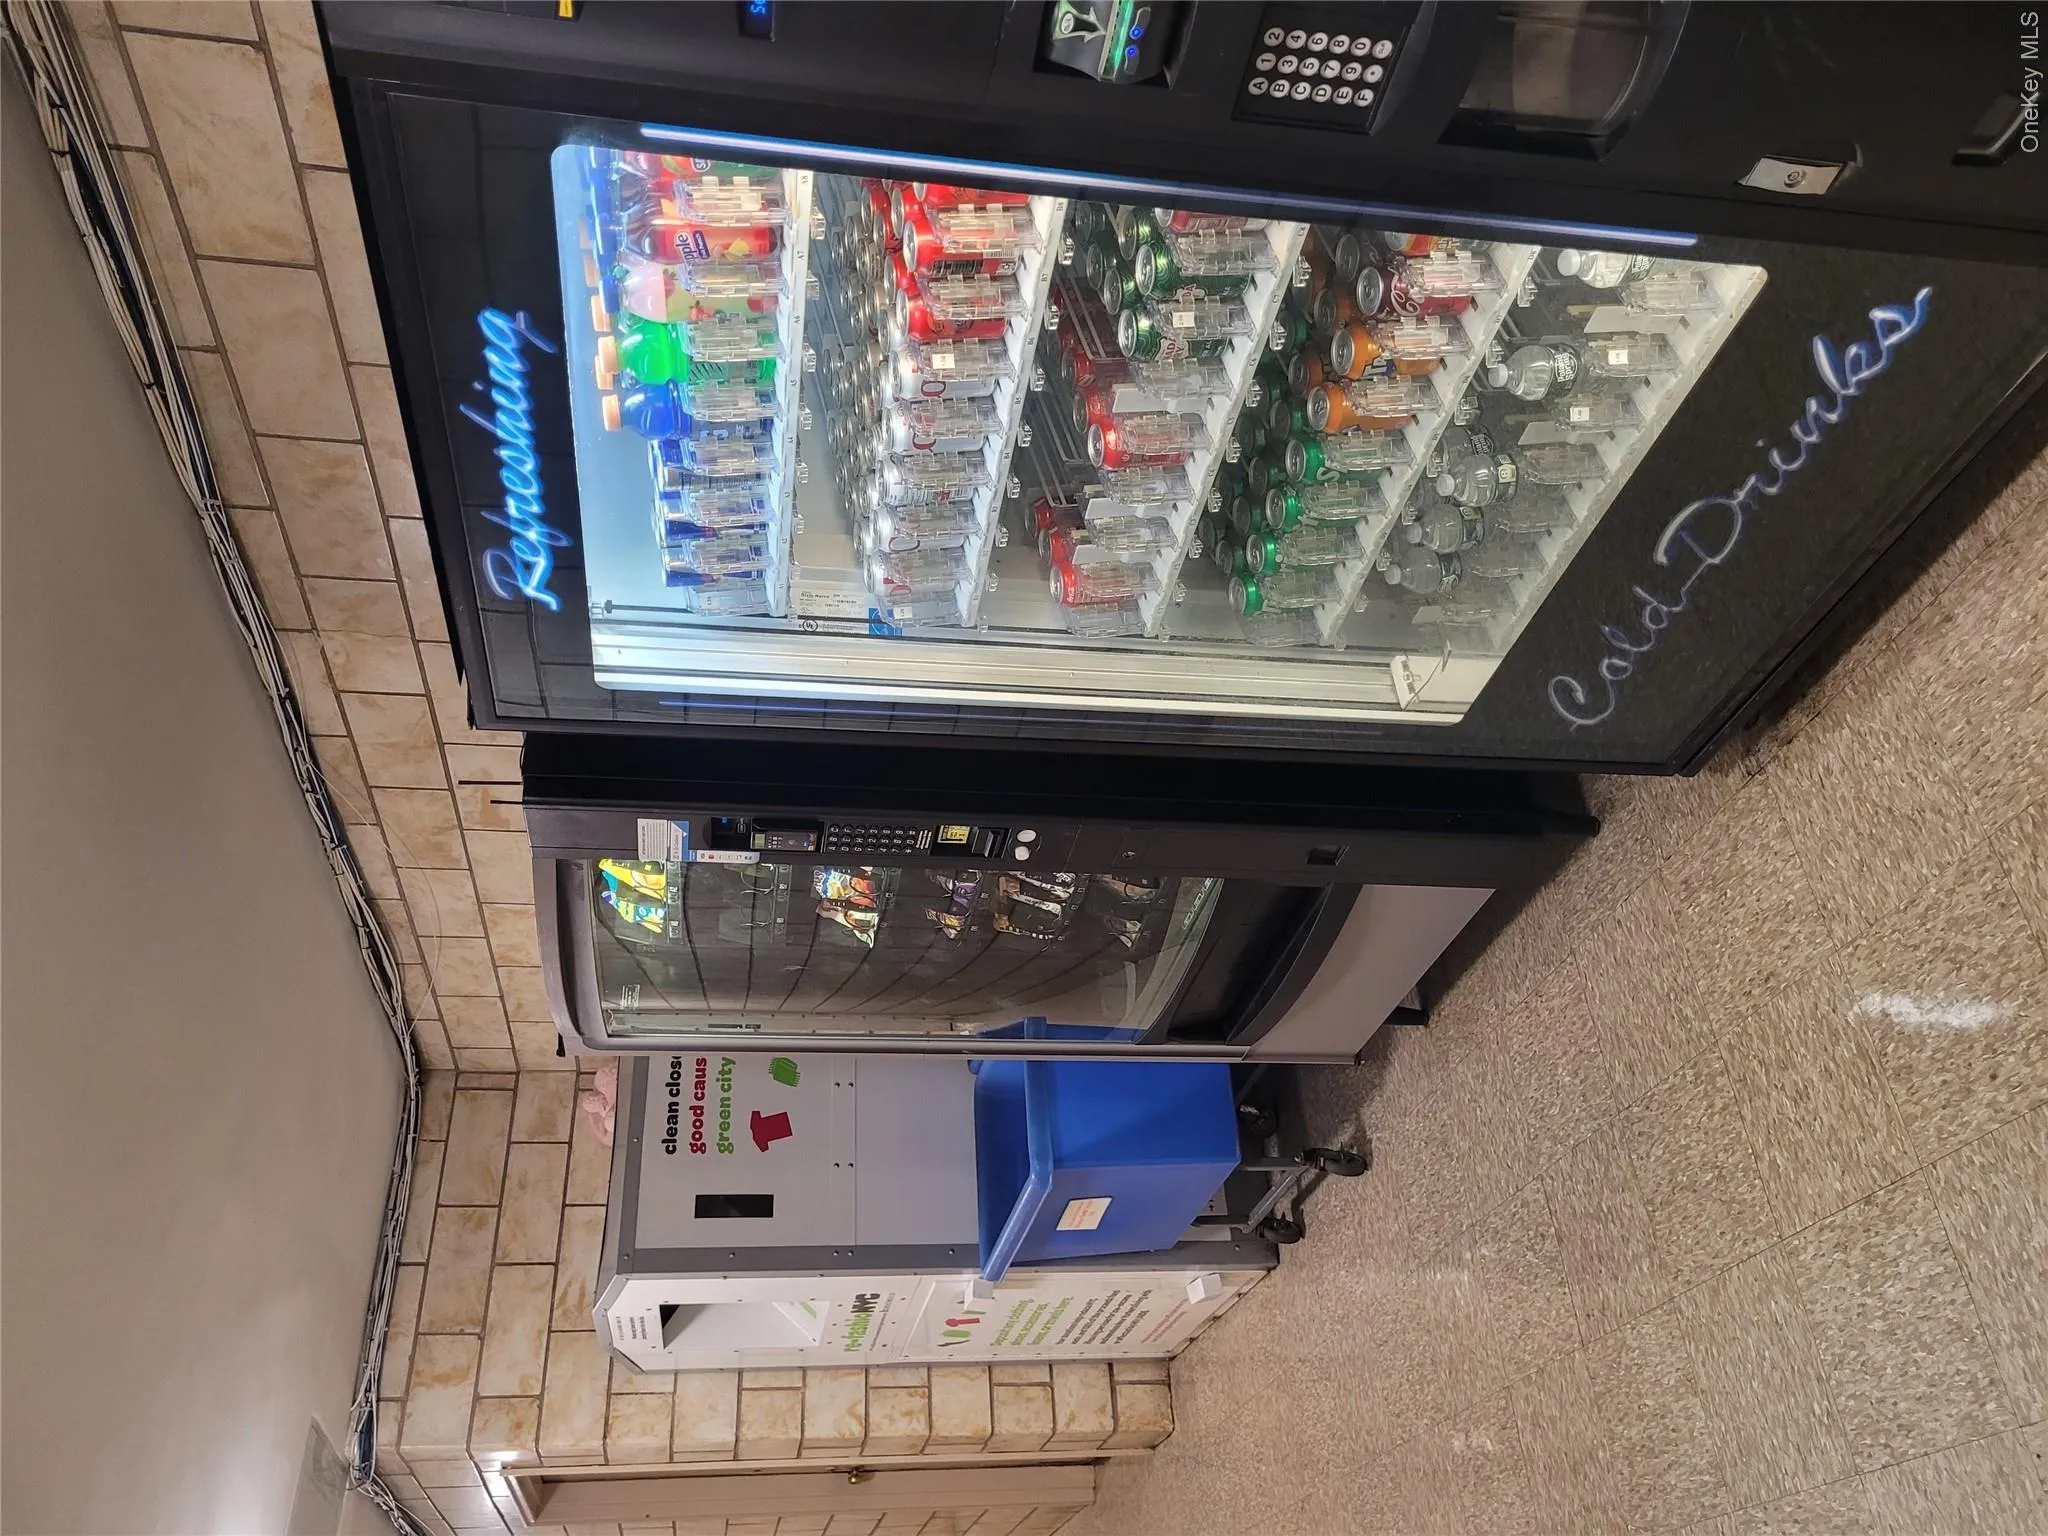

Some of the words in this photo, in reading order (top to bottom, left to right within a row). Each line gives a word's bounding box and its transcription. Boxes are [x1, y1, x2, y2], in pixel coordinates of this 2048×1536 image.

[1269, 32, 1279, 40] 2
[1355, 42, 1366, 50] 0
[1274, 84, 1284, 92] B
[1295, 86, 1306, 94] C
[1316, 88, 1326, 96] D
[1358, 93, 1368, 101] F
[796, 250, 804, 260] A7
[1040, 272, 1048, 282] B7
[793, 315, 800, 324] A6
[1554, 354, 1566, 382] Poland
[1562, 352, 1574, 380] Spring
[460, 308, 573, 611] Refreshing
[1548, 584, 1687, 731] Cold
[1652, 286, 1933, 566] Drinks
[716, 1056, 736, 1093] city
[661, 1102, 679, 1154] clean
[689, 1105, 706, 1154] good
[716, 1096, 734, 1154] green
